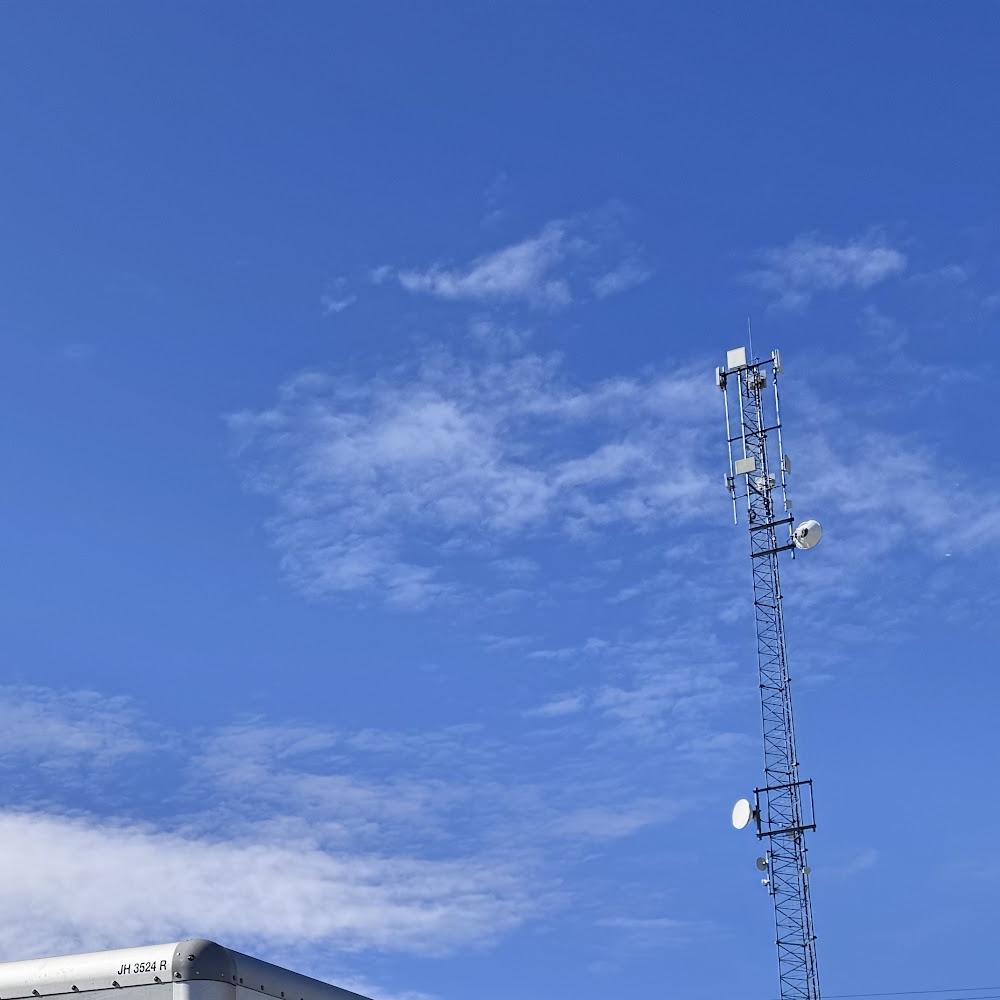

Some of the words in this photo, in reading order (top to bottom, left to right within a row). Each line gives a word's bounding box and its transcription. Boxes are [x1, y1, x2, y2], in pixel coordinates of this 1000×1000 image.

[117, 963, 132, 976] JH
[133, 960, 156, 974] 3524
[158, 959, 168, 972] R
